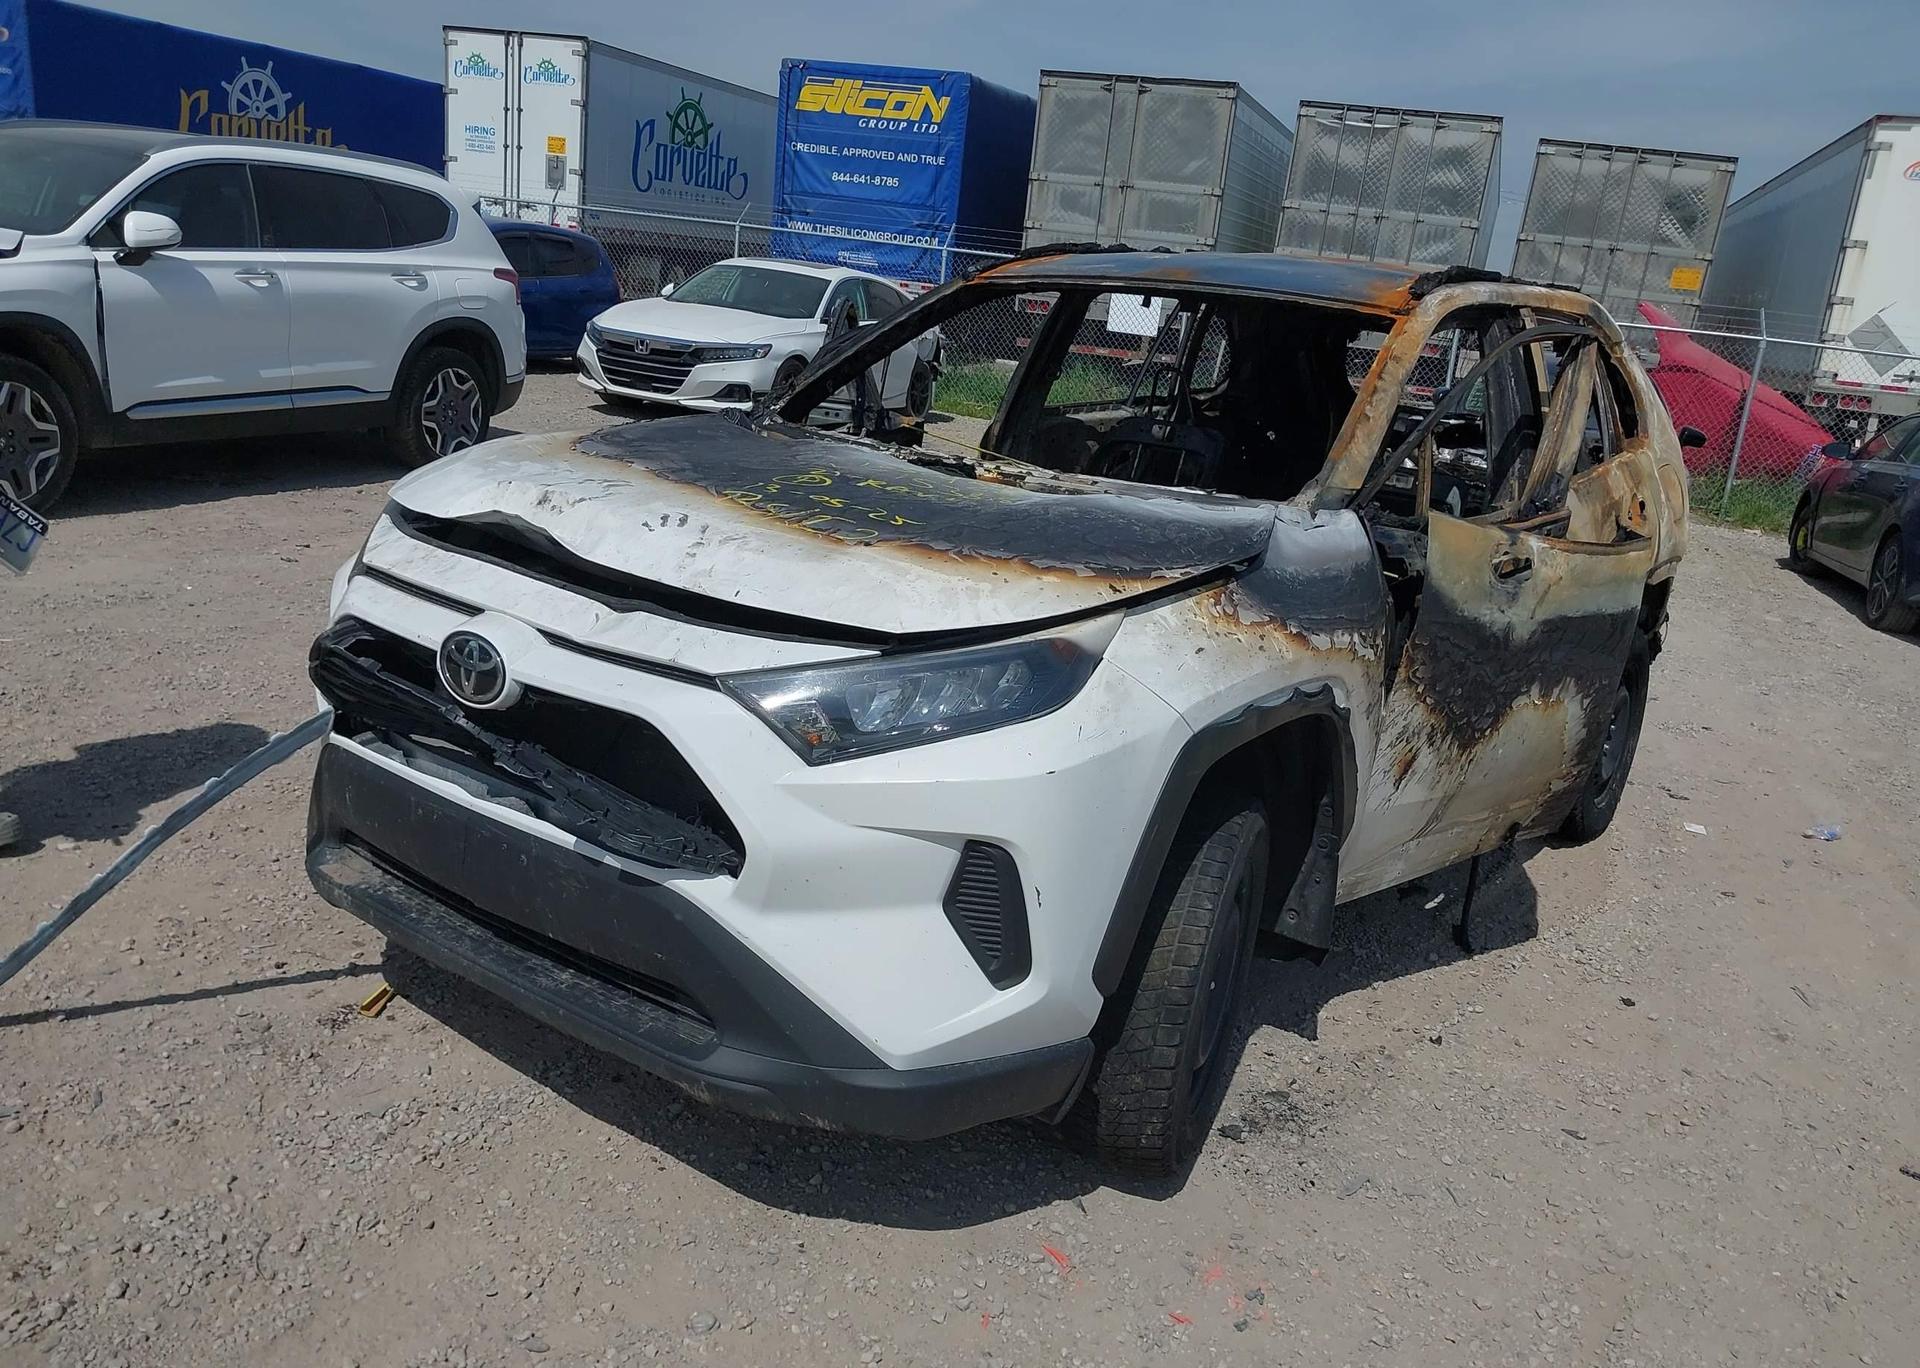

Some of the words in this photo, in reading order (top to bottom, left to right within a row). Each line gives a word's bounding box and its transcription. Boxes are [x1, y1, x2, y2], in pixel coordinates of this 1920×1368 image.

[454, 59, 504, 80] Corvette
[523, 65, 576, 86] Corvette
[464, 125, 496, 136] HIRING
[858, 118, 907, 131] GROUP
[631, 118, 749, 200] Corvette
[790, 141, 841, 157] CREDIBLE,
[842, 147, 895, 161] APPROVED
[896, 152, 918, 163] AND
[920, 154, 946, 166] TRUE
[831, 171, 899, 187] 844-641-8785
[785, 219, 939, 247] WWW.THESILICONGROUP.COM
